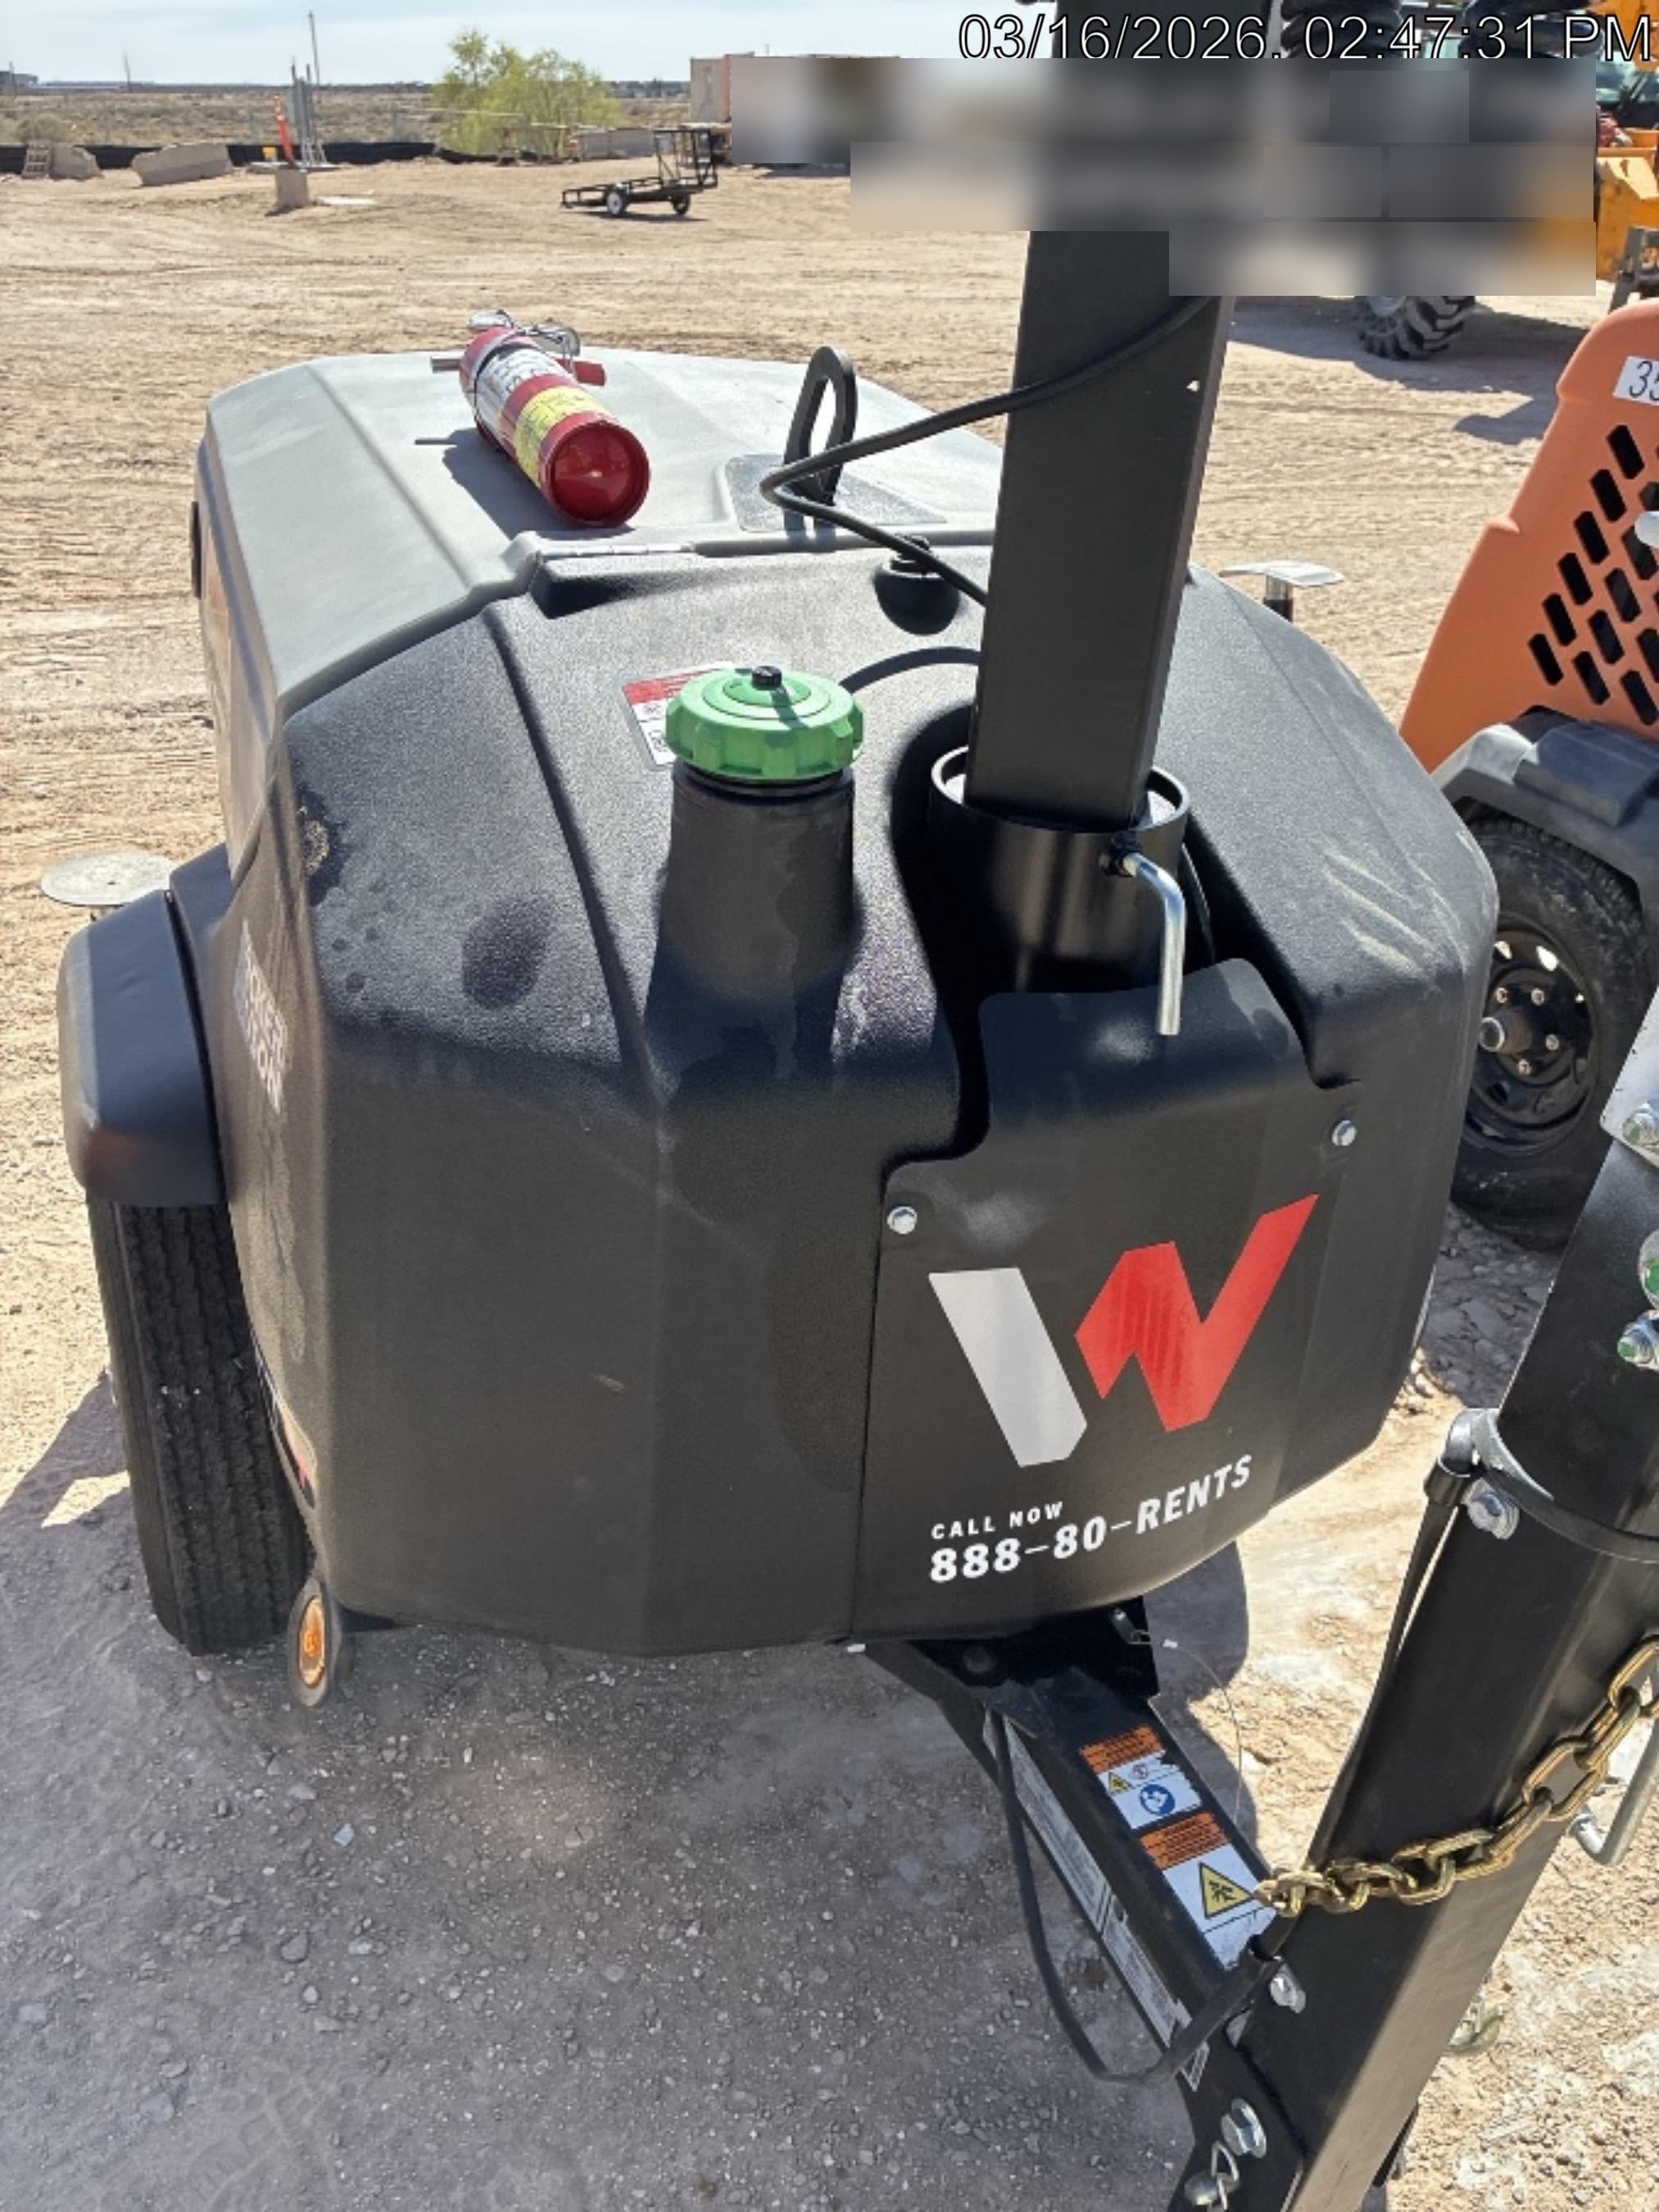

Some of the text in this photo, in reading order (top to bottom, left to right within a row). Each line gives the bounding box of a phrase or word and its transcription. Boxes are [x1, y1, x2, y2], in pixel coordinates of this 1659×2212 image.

[929, 1454, 1252, 1584] 888-80-RENTS
[931, 1501, 1063, 1540] CALL NOW
